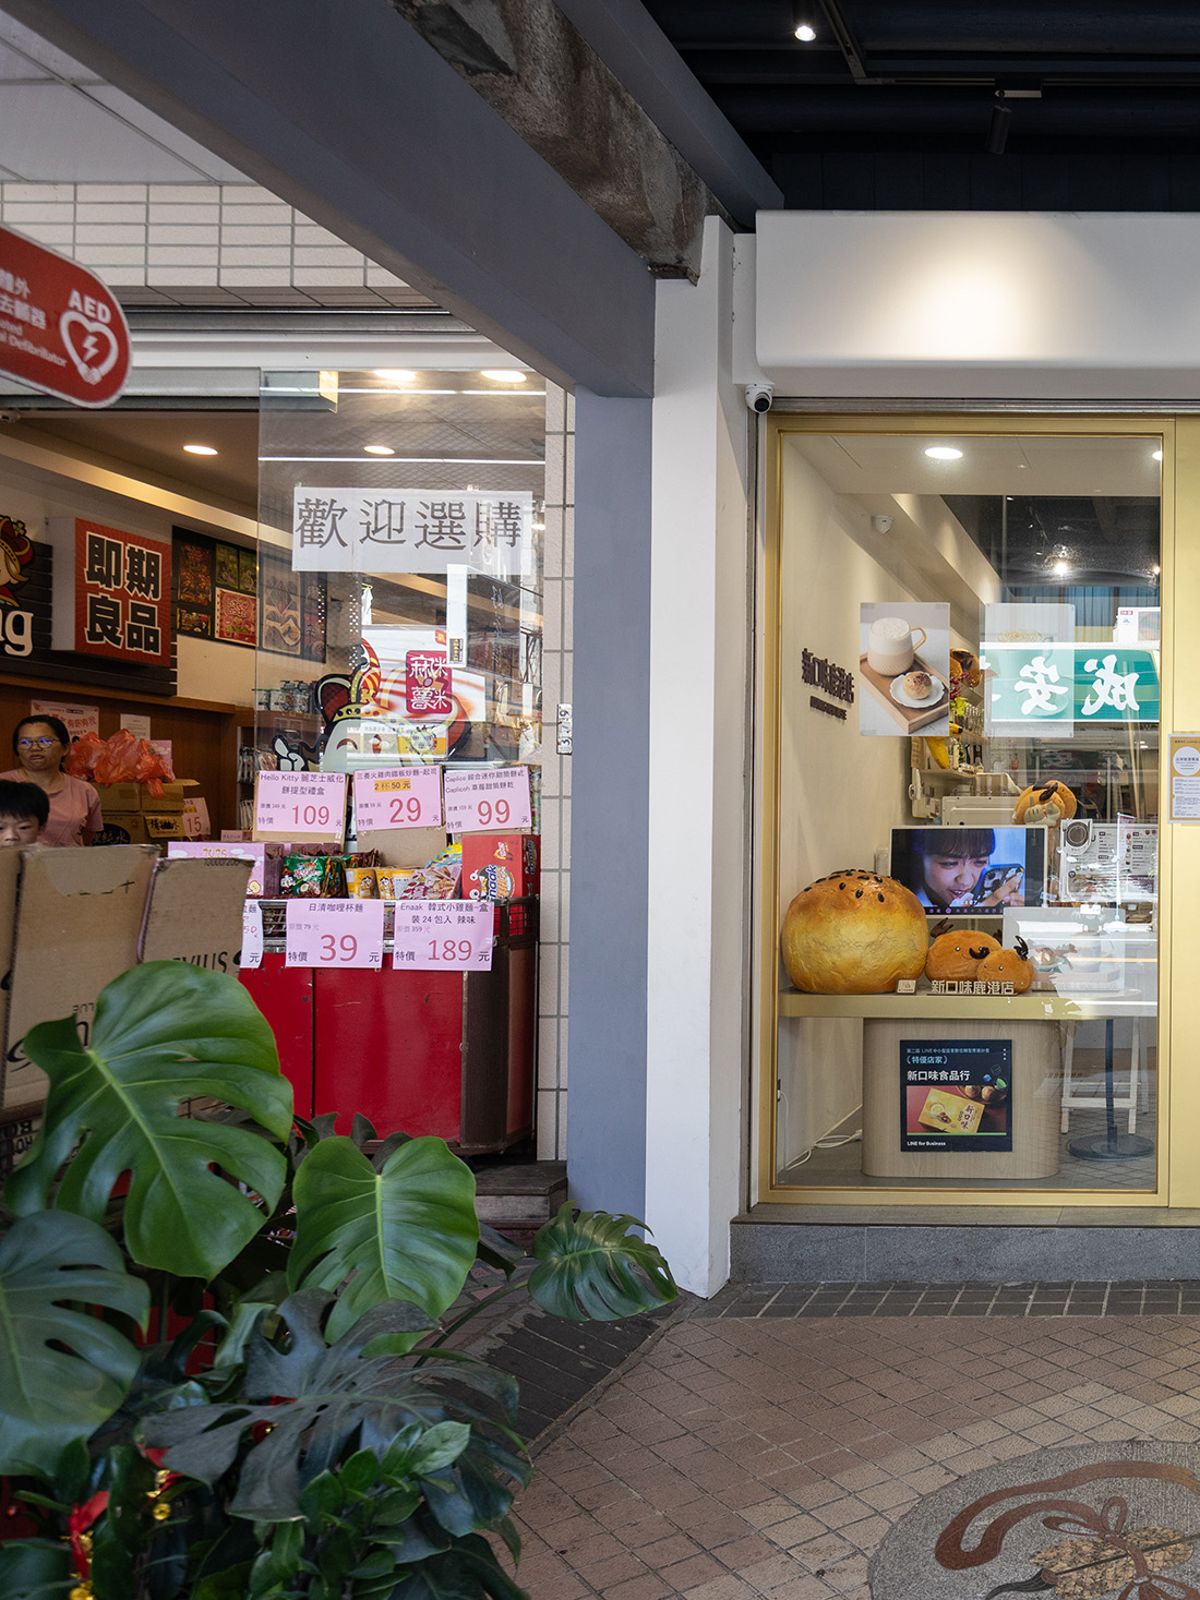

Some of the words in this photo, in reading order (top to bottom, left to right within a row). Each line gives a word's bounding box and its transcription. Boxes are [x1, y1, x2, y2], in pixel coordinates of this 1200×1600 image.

[68, 288, 112, 324] AED
[296, 498, 523, 551] 歡迎選購
[84, 531, 162, 601] 即期
[84, 593, 162, 656] 良品
[260, 773, 280, 781] Hello
[281, 774, 299, 782] Kitty
[292, 804, 330, 826] 109
[389, 796, 422, 824] 29
[477, 798, 511, 826] 99
[187, 817, 202, 833] 15
[400, 903, 423, 911] Enaak
[422, 915, 432, 923] 24
[319, 934, 358, 962] 39
[428, 939, 473, 962] 189
[249, 952, 260, 963] 元
[288, 951, 308, 962] 特價
[368, 951, 380, 963] 元
[395, 951, 415, 962] 特價
[478, 951, 490, 962] 元
[931, 980, 1015, 995] 新口味鹿港店
[907, 1070, 971, 1081] 新口味食品行
